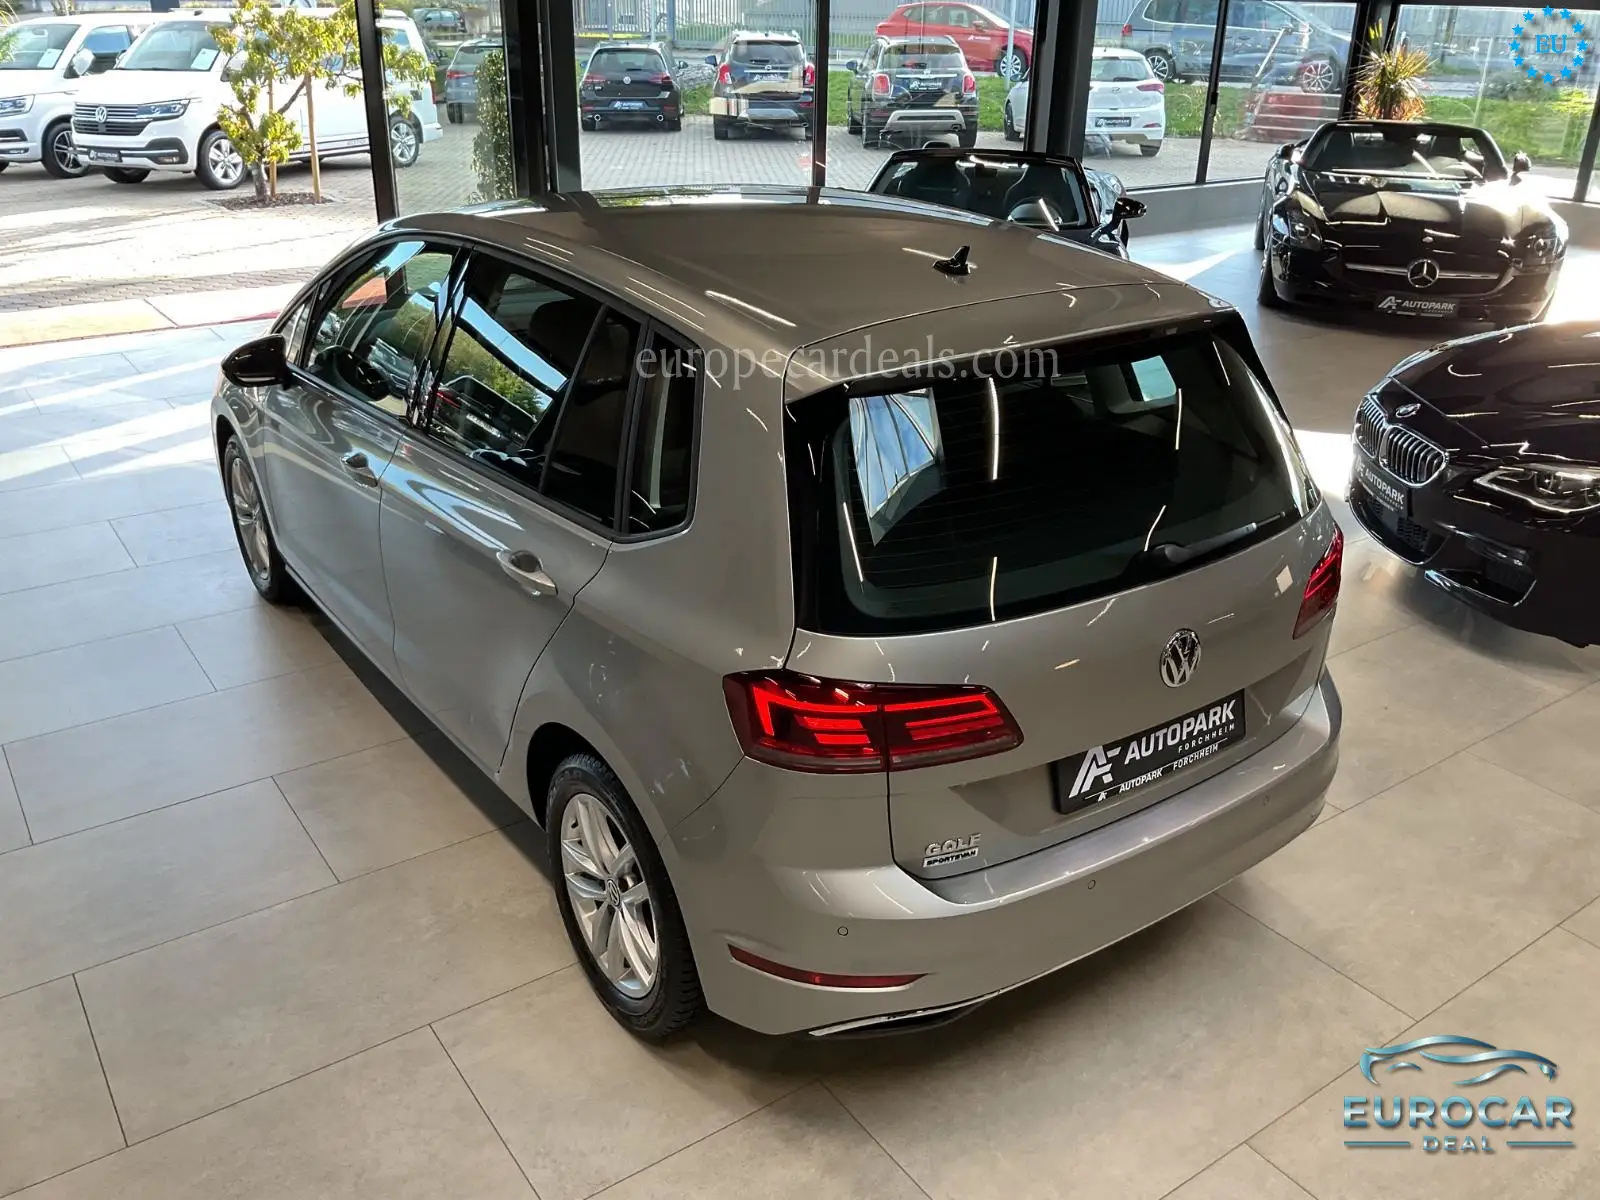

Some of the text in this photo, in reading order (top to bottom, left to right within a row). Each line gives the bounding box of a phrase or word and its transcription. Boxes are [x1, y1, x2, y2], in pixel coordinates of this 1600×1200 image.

[1401, 300, 1456, 310] AUTOPARK
[1365, 468, 1405, 505] AUTOPARK
[1124, 700, 1236, 765] AUTOPARK
[1178, 723, 1235, 754] FORCHHEIM
[1119, 768, 1163, 793] AUTOPARK
[1173, 743, 1218, 771] FORCHHEIM
[925, 832, 982, 856] GOLF
[925, 849, 977, 867] SPORTSVAN
